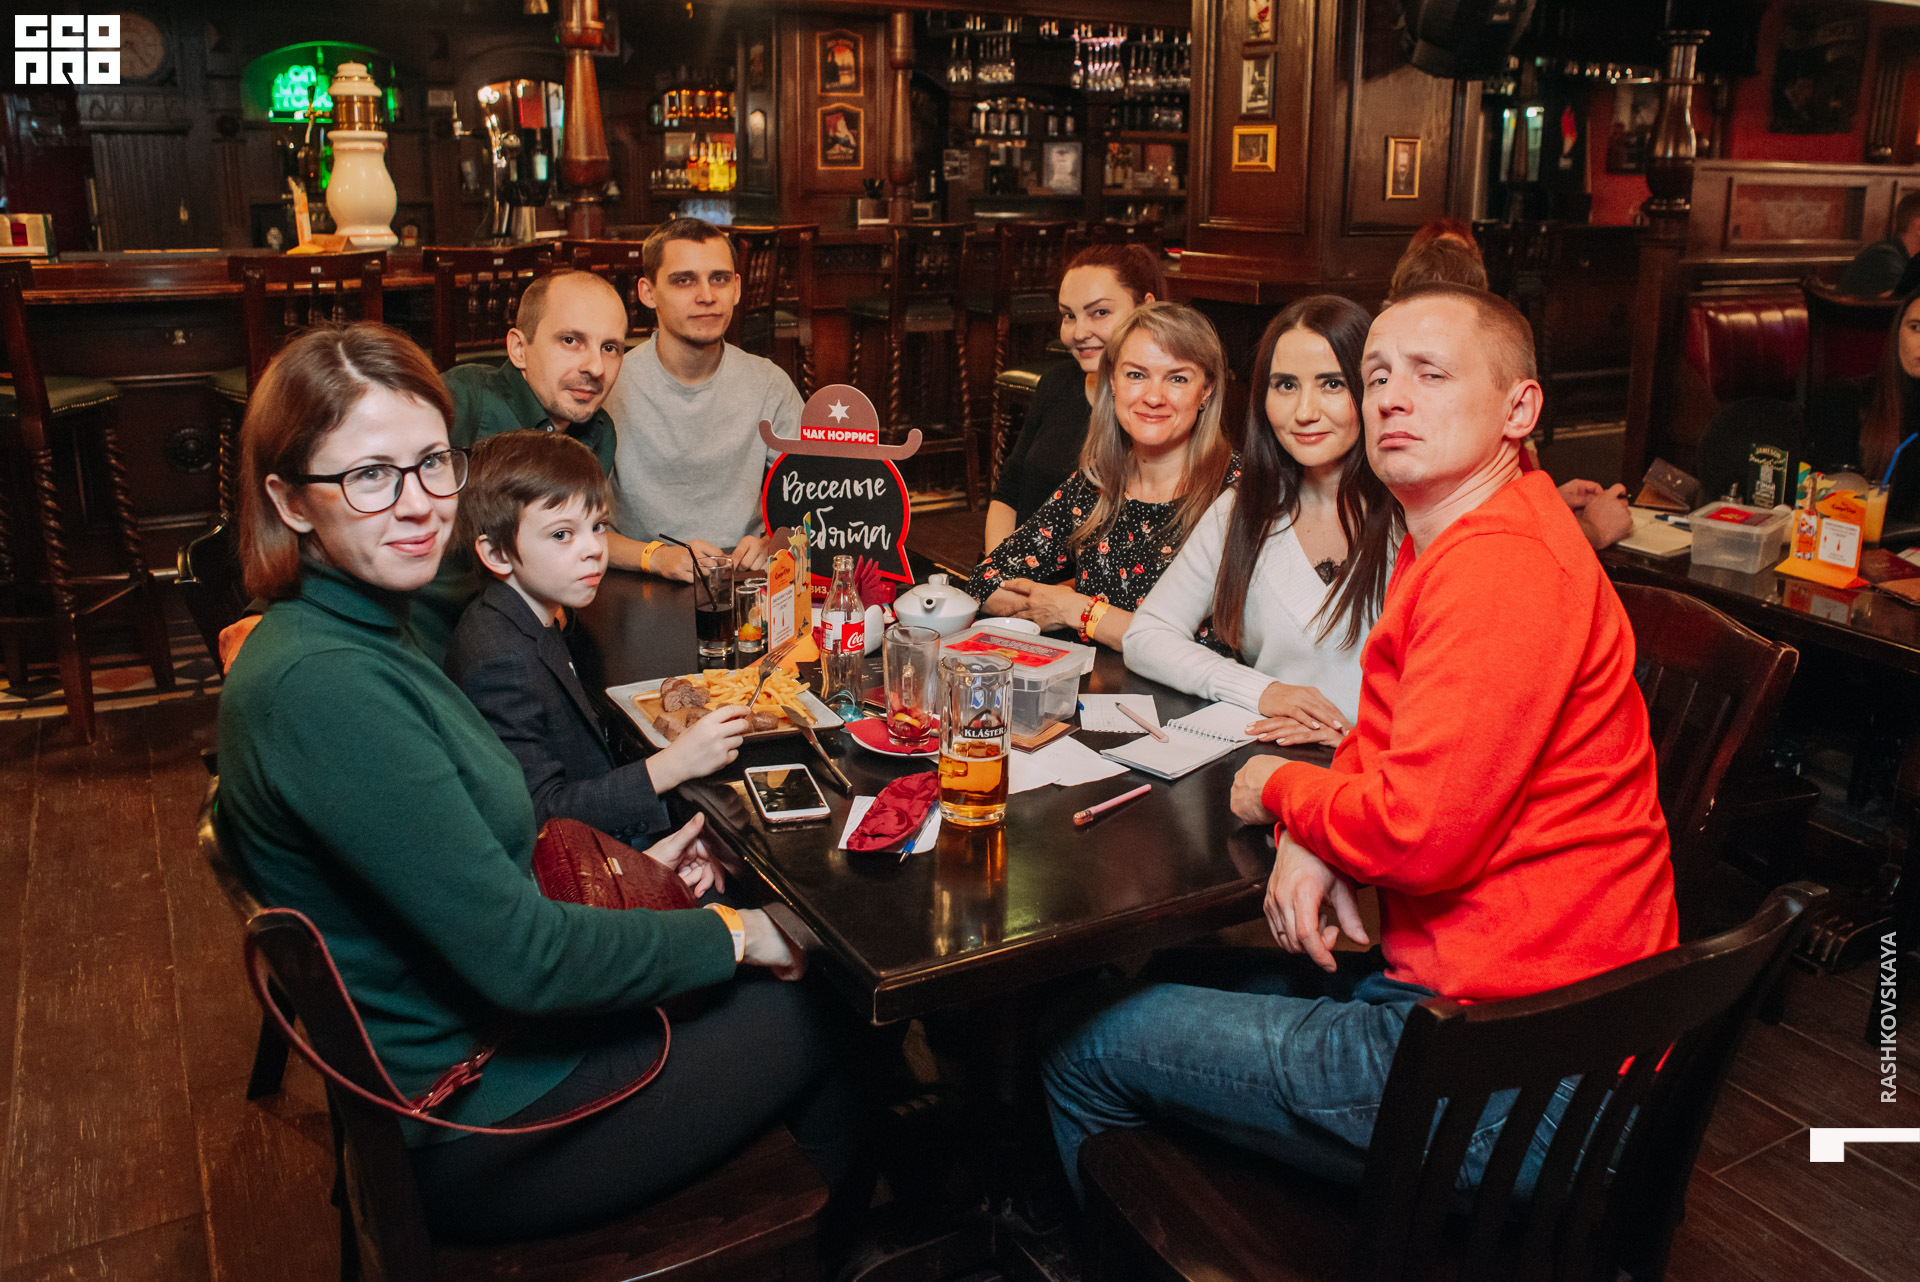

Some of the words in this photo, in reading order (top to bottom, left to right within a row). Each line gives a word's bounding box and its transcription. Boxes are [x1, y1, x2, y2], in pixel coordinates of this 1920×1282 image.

[802, 428, 826, 440] ЧАК
[827, 430, 875, 443] НОРРИС
[782, 470, 887, 505] Веселые
[791, 505, 891, 551] ебята
